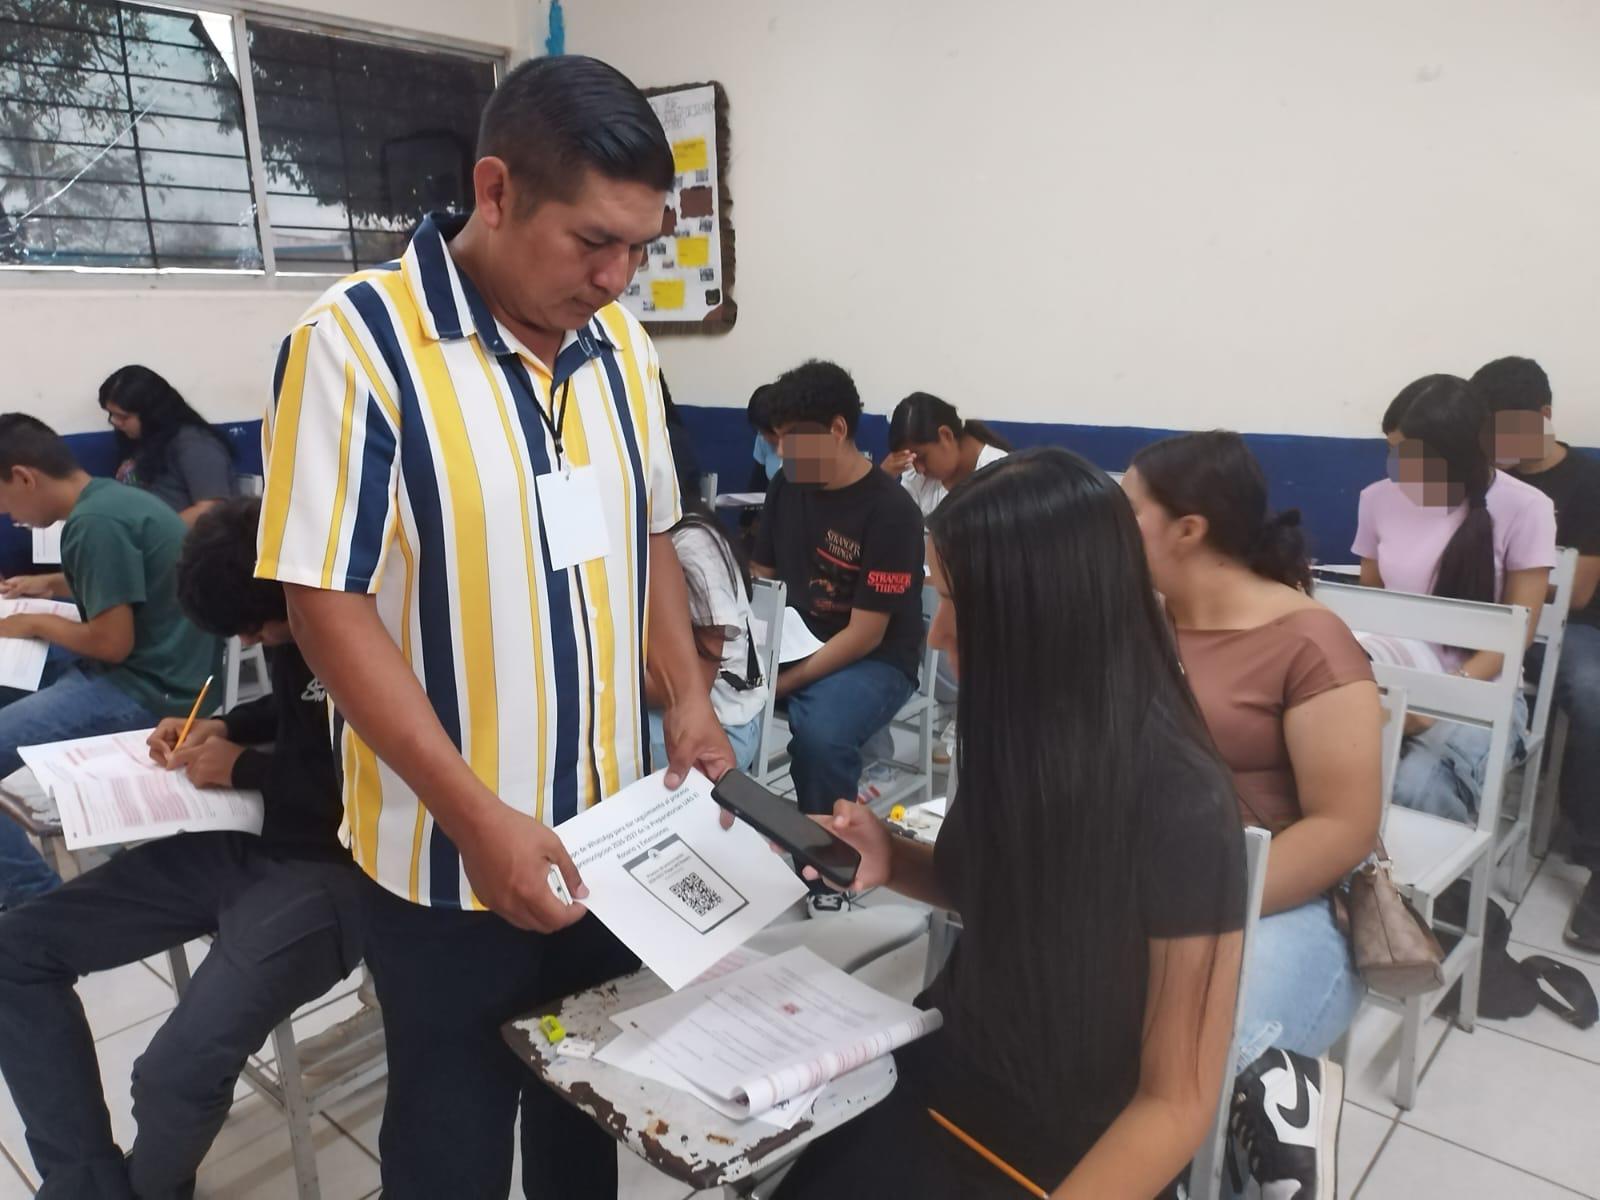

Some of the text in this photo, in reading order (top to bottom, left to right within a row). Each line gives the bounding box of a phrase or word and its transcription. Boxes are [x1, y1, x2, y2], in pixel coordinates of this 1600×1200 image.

[826, 528, 861, 559] STRANGER
[828, 542, 853, 561] THINGS
[867, 571, 912, 588] STRANGER
[875, 583, 905, 593] THINGS
